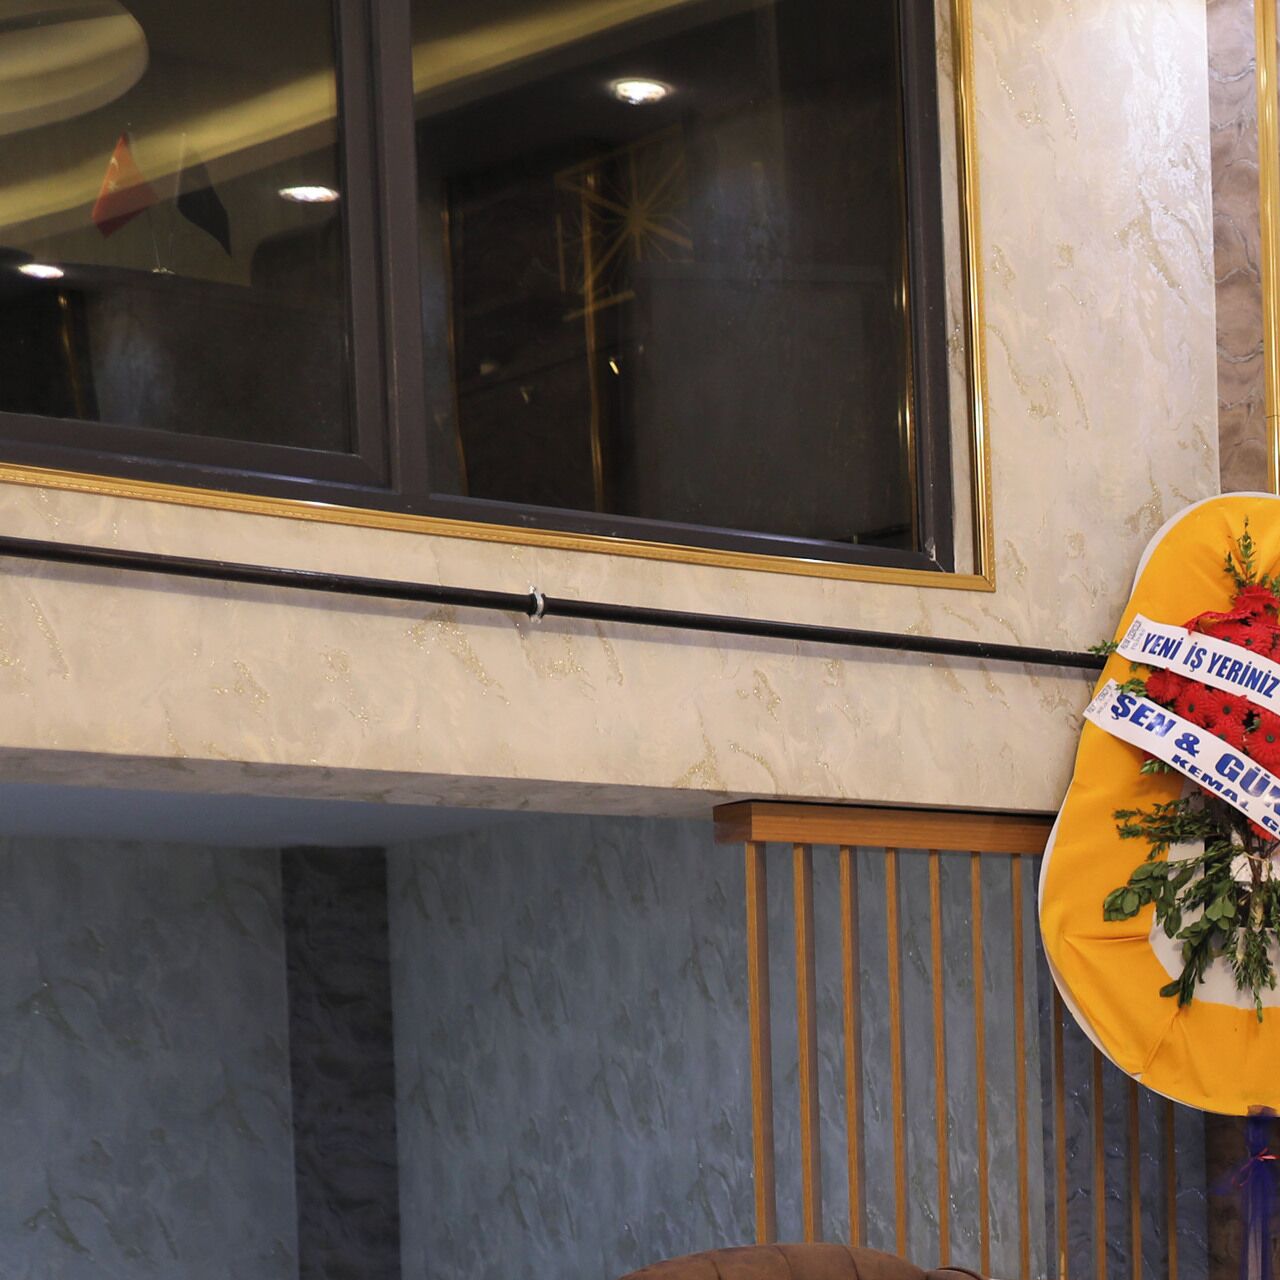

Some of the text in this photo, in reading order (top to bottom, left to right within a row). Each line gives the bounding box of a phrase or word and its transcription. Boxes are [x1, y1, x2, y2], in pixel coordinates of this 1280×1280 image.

[1140, 633, 1184, 660] YENİ
[1183, 641, 1207, 672] İŞ
[1207, 653, 1280, 698] YERİNİZ
[1110, 694, 1176, 738] ŞEN
[1174, 732, 1200, 758] &
[1171, 754, 1249, 812] KEMAL
